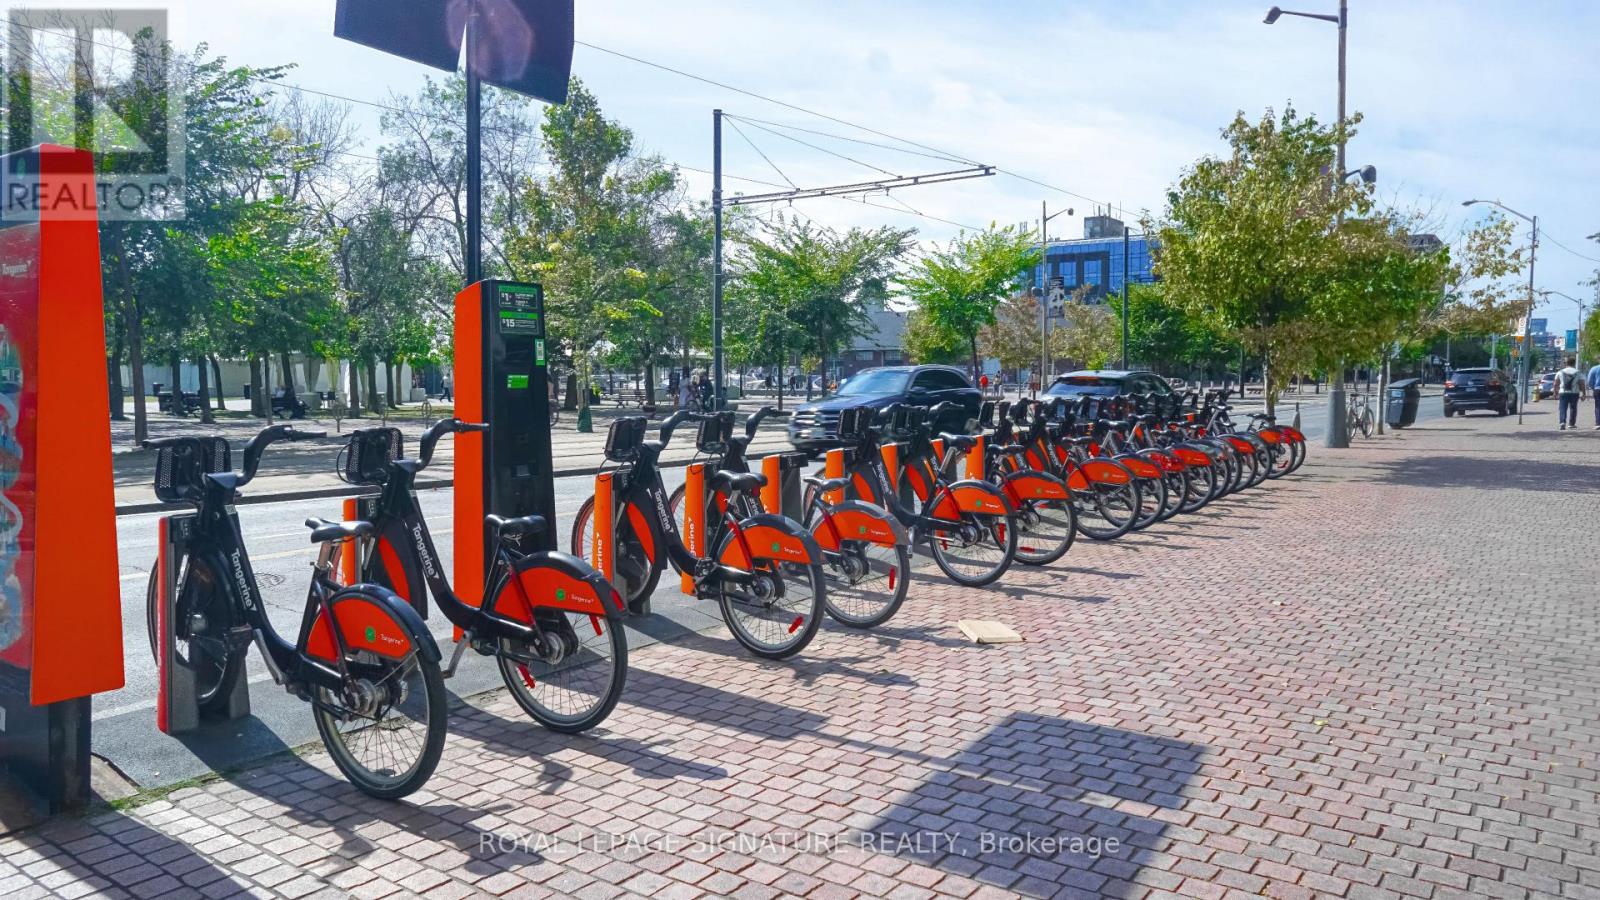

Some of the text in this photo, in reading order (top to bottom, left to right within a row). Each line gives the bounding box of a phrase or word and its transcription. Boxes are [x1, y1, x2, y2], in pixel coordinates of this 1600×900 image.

[654, 488, 672, 531] Tangerine
[412, 523, 435, 577] Tangerine
[689, 523, 697, 557] gerine
[231, 547, 254, 608] Tangerine
